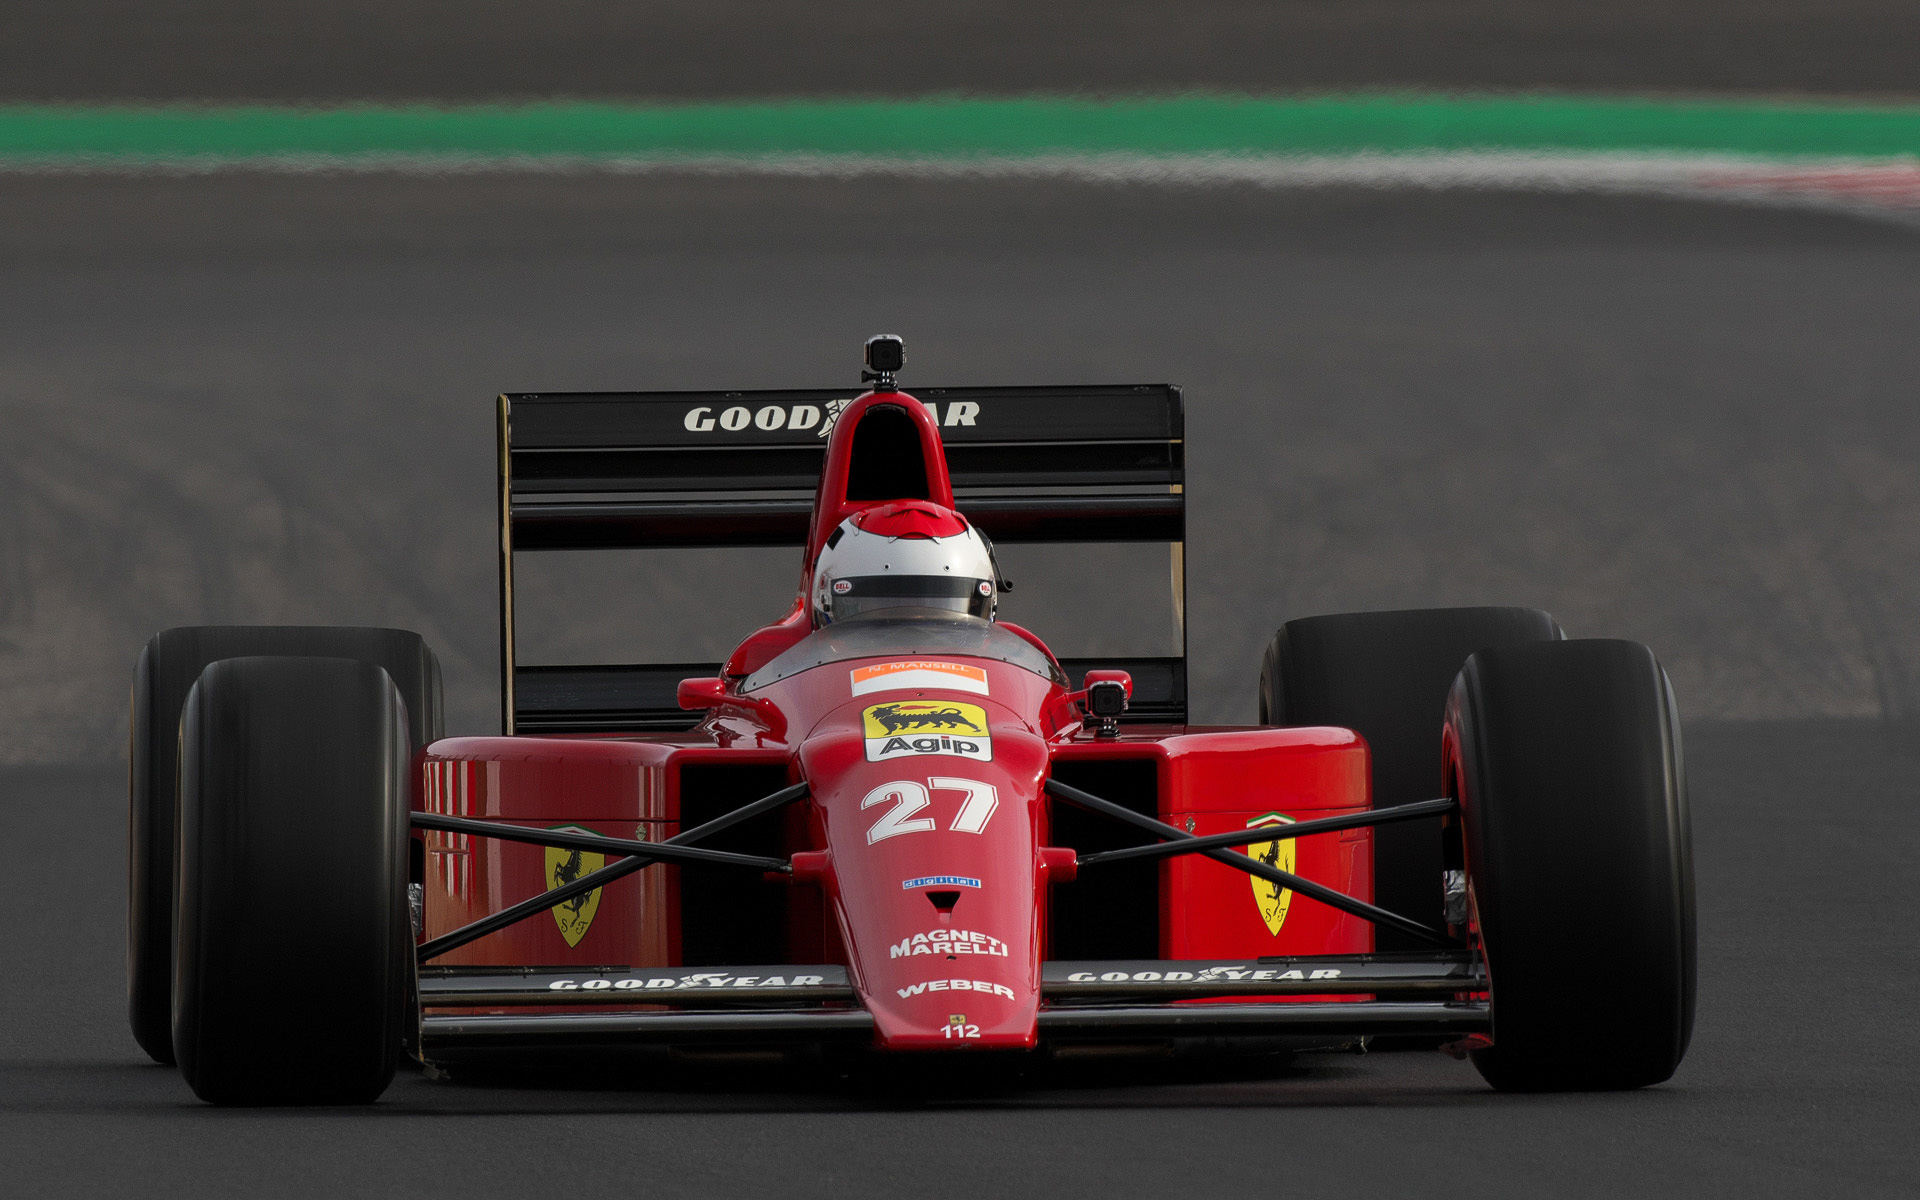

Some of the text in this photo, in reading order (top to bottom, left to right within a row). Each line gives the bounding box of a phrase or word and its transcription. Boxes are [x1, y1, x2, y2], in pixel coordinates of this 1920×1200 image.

[868, 663, 970, 673] N. MANSELL
[879, 736, 980, 756] Agip
[861, 776, 1000, 846] 27
[903, 876, 980, 888] digital
[1265, 907, 1272, 922] S
[560, 918, 569, 933] S
[890, 929, 1008, 956] MAGNETI
[890, 939, 1008, 959] MARELLI
[549, 974, 824, 990] GOODYEAR
[1067, 967, 1342, 982] GOODYEAR
[897, 979, 1015, 1001] WEBER
[940, 1024, 981, 1039] 112
